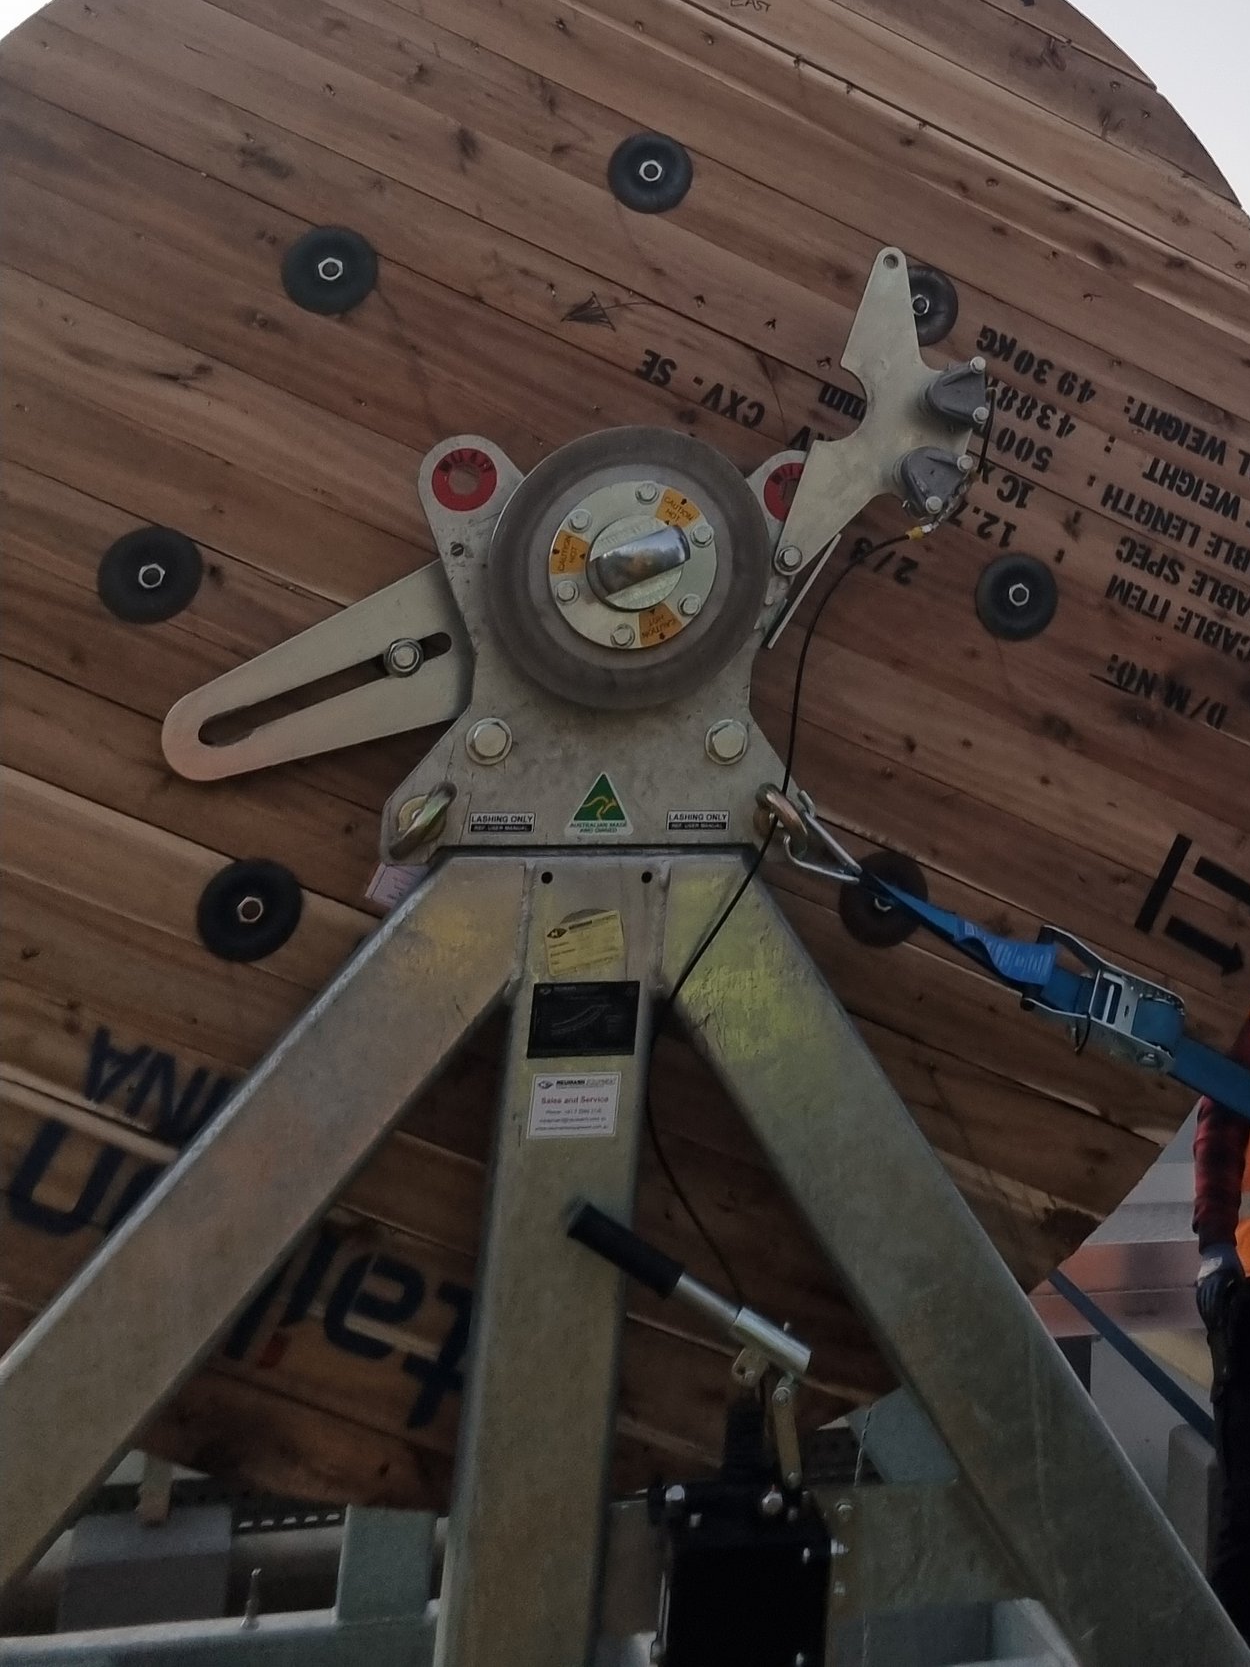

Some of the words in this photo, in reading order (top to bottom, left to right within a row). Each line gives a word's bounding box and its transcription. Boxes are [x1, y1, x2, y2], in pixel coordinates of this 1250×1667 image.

[636, 349, 678, 386] SE
[1124, 396, 1227, 466] WEIGHT:
[1142, 457, 1241, 521] WEIGHT
[664, 497, 693, 521] CAUTION
[665, 509, 680, 522] HOT
[1100, 484, 1201, 548] LENGTH
[559, 536, 572, 572] CAUTION
[569, 547, 579, 564] HOT
[1115, 535, 1186, 585] SPEC
[1105, 574, 1171, 623] ITEM
[471, 815, 509, 823] LASHING
[511, 815, 533, 823] ONLY
[669, 813, 704, 821] LASHING
[706, 813, 728, 821] ONLY
